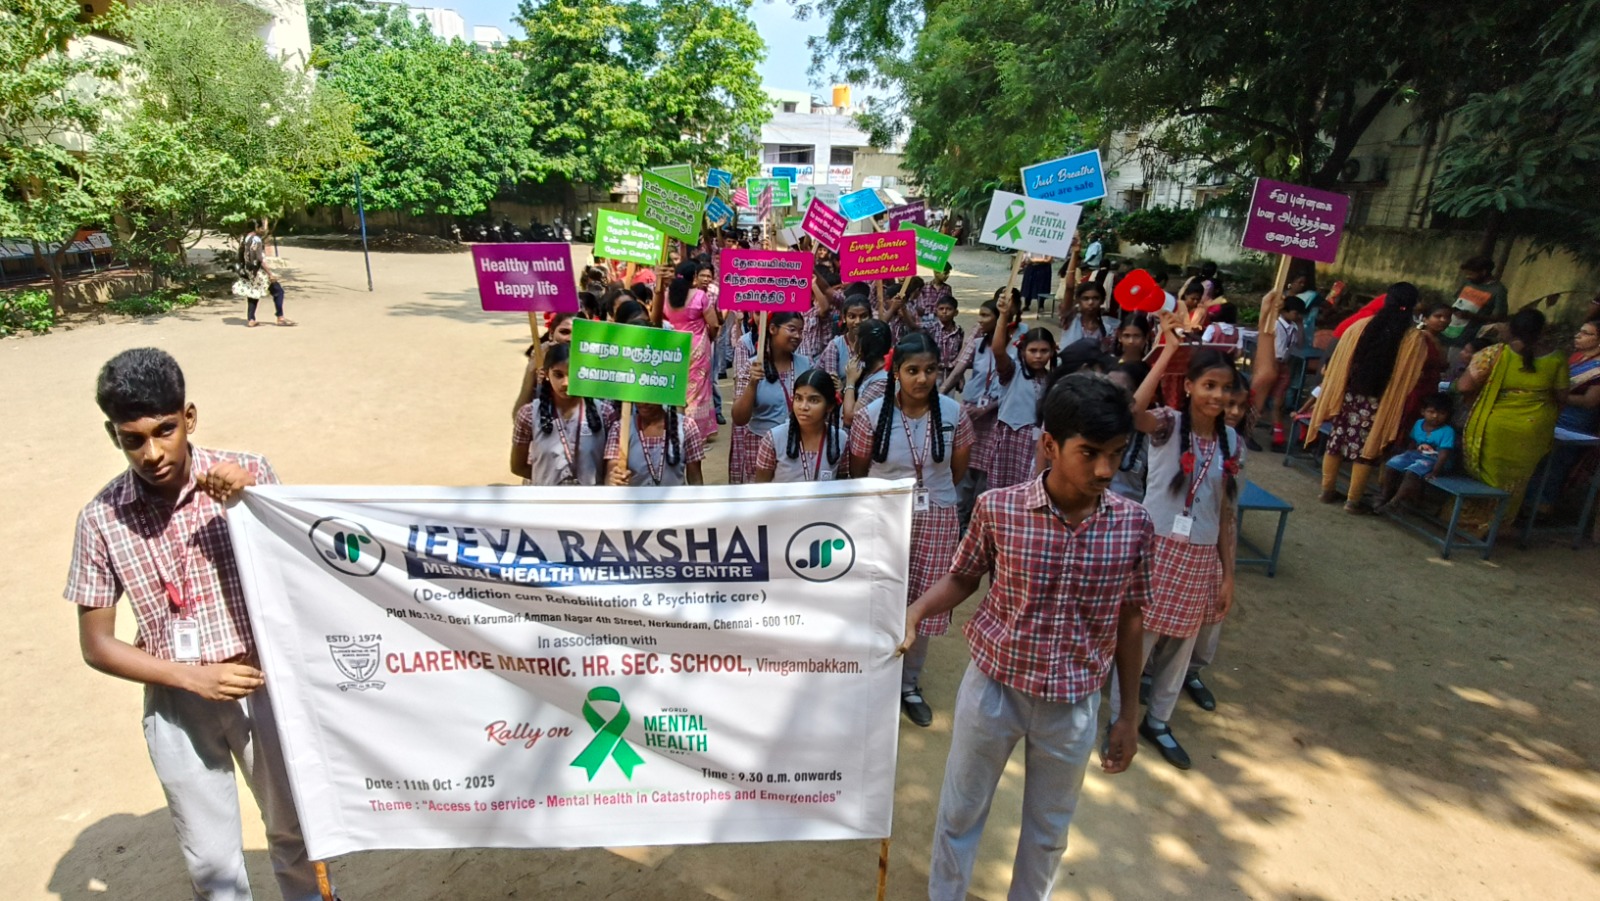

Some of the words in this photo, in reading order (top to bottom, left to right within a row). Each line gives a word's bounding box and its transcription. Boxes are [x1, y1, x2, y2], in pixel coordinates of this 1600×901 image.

[1032, 173, 1054, 190] Just
[1057, 165, 1096, 182] Breathe
[1058, 186, 1072, 195] are
[1074, 180, 1094, 192] safe
[1269, 189, 1288, 204] சிறு
[1290, 193, 1333, 211] புன்னகை
[1031, 214, 1067, 230] MENTAL
[1257, 207, 1275, 223] மன
[1277, 211, 1336, 237] அழுத்தத்தை
[1028, 225, 1065, 241] HEALTH
[1265, 232, 1318, 249] குறைக்கும்.
[849, 241, 875, 254] Every
[876, 238, 908, 250] Sunrise
[480, 257, 529, 275] Healthy
[532, 257, 566, 272] mind
[858, 255, 865, 263] is
[865, 252, 899, 263] another
[849, 266, 879, 277] chance
[880, 265, 888, 273] to
[890, 263, 910, 273] heal
[494, 280, 534, 298] Happy
[537, 280, 559, 296] life
[723, 272, 809, 288] சிந்தனைகளுக்கு
[579, 341, 619, 358] மனநல
[622, 344, 683, 366] மருத்துவம்
[577, 366, 636, 384] அவமானம்
[638, 370, 669, 387] அல்ல
[423, 562, 496, 580] MENTAL
[500, 567, 574, 582] HEALTH
[580, 565, 676, 581] WELLNESS
[682, 565, 754, 579] CENTRE
[515, 593, 542, 602] cum
[545, 594, 638, 609] Rehabilitation
[643, 594, 653, 606] &
[657, 591, 727, 609] Psychiatric
[731, 590, 768, 604] care)
[386, 608, 407, 618] Plot
[448, 615, 471, 625] Devi
[474, 612, 521, 625] Karumari
[524, 612, 562, 623] Amman
[565, 613, 592, 624] Nagar
[596, 614, 611, 624] 4th
[614, 617, 646, 627] Street,
[649, 619, 711, 631] Nerkundram,
[714, 617, 752, 630] Chennai
[762, 615, 780, 628] 600
[783, 614, 804, 627] 107.
[325, 635, 350, 643] ESTD
[359, 634, 382, 643] 1974
[538, 636, 550, 648] In
[554, 634, 628, 648] association
[630, 634, 657, 646] with
[385, 650, 494, 674] CLARENCE
[497, 655, 577, 678] MATRIC.
[583, 654, 616, 677] HR.
[621, 653, 664, 676] SEC.
[670, 652, 752, 678] SCHOOL,
[756, 656, 863, 677] Virugambakkam.
[643, 714, 708, 732] MENTAL
[484, 720, 545, 749] Rally
[547, 725, 573, 738] on
[645, 733, 708, 752] HEALTH
[365, 777, 393, 790] Date
[403, 778, 430, 790] 11th
[432, 778, 452, 791] Oct
[464, 775, 495, 790] 2025
[700, 767, 728, 780] Time
[738, 771, 763, 783] 9.30
[766, 773, 791, 783] a.m.
[794, 769, 842, 783] onwards
[369, 799, 412, 812] Theme
[475, 799, 487, 812] to
[490, 796, 536, 811] service
[546, 793, 590, 808] Mental
[593, 792, 633, 805] Health
[637, 791, 648, 804] in
[651, 789, 731, 804] Catastrophes
[735, 789, 756, 801] and
